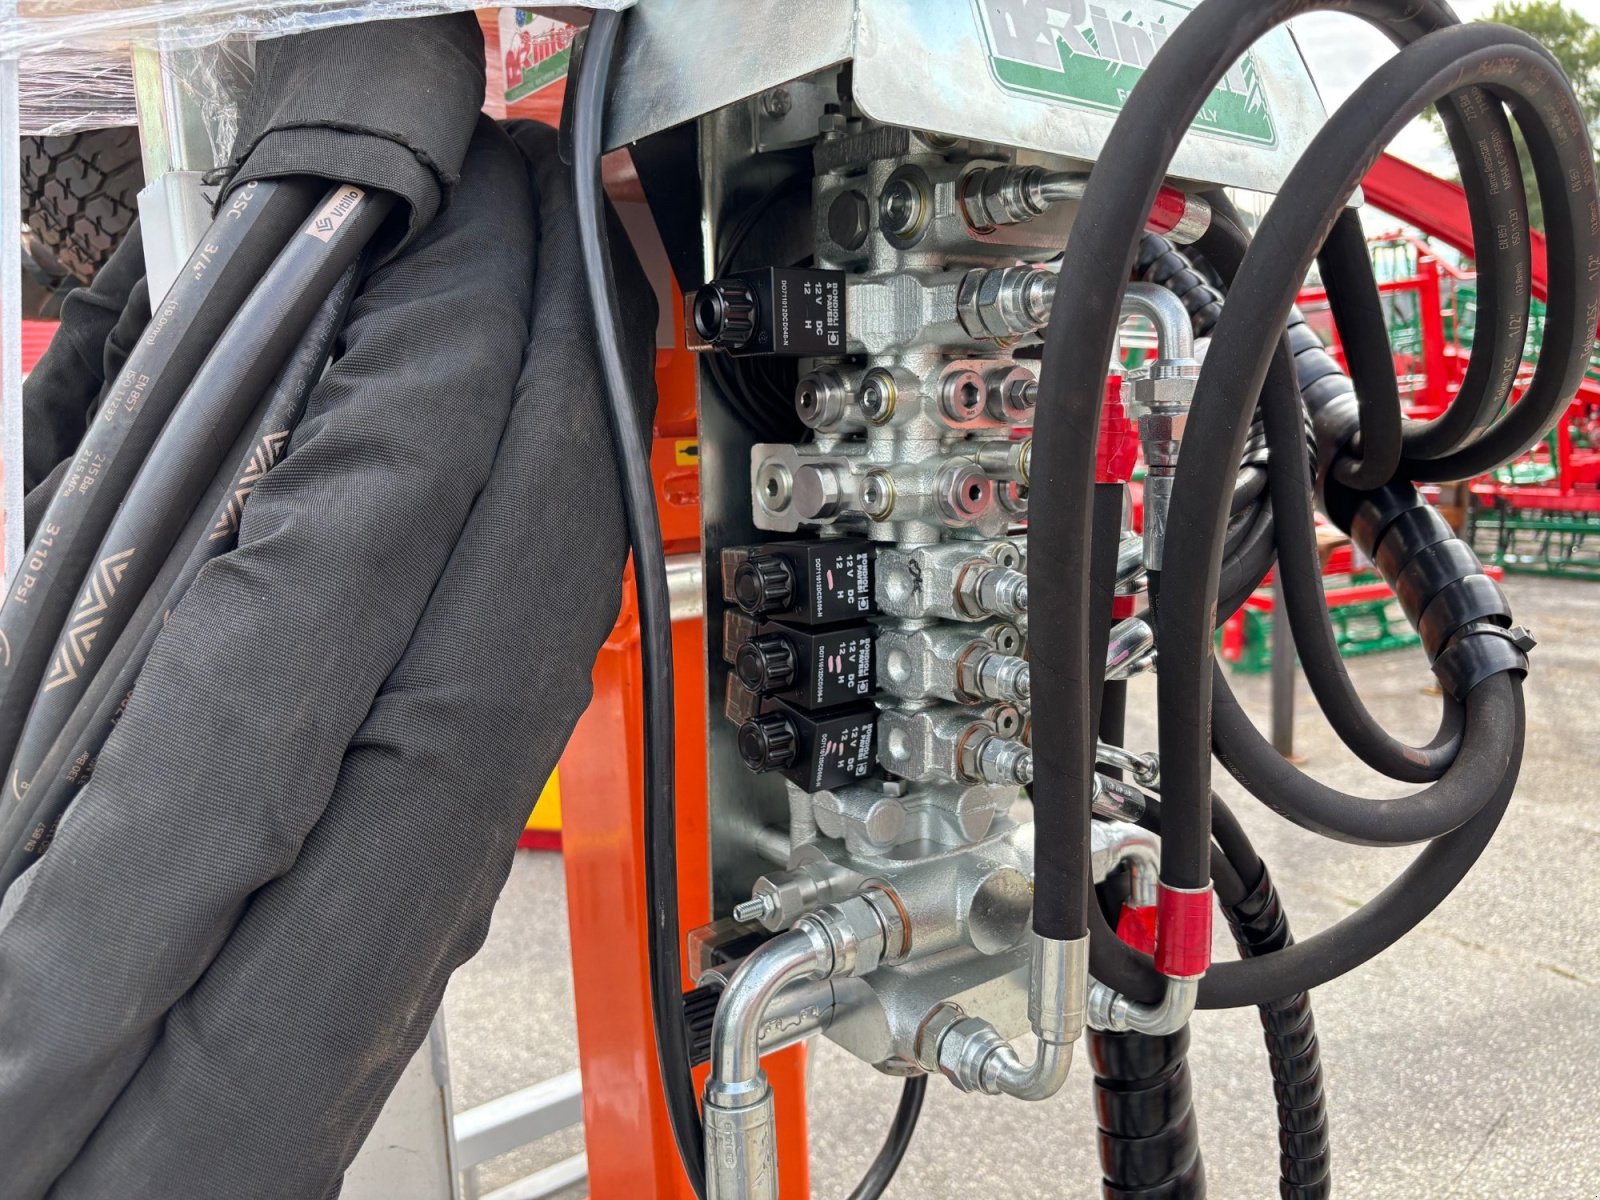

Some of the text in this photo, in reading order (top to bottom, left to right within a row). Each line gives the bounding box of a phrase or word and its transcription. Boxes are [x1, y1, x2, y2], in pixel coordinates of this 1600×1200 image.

[226, 191, 254, 219] 2SC
[330, 191, 358, 217] Vitillo
[193, 243, 218, 280] 3/4"
[804, 281, 812, 329] 12 H
[815, 282, 823, 336] 12 V DC
[1508, 314, 1522, 338] 1/2"
[1503, 353, 1517, 375] 2SC
[105, 369, 138, 421] ISO 11237
[124, 374, 150, 412] EN 857
[62, 473, 78, 497] MPa
[78, 453, 106, 495] 215 Bar
[14, 522, 61, 604] 3110 Psi
[836, 555, 844, 599] 12 H
[846, 554, 855, 604] 12 V DC
[837, 641, 846, 684] 12 H
[847, 640, 857, 688] 12 V DC
[837, 728, 849, 768] 12 H
[846, 726, 859, 772] 12 V DC
